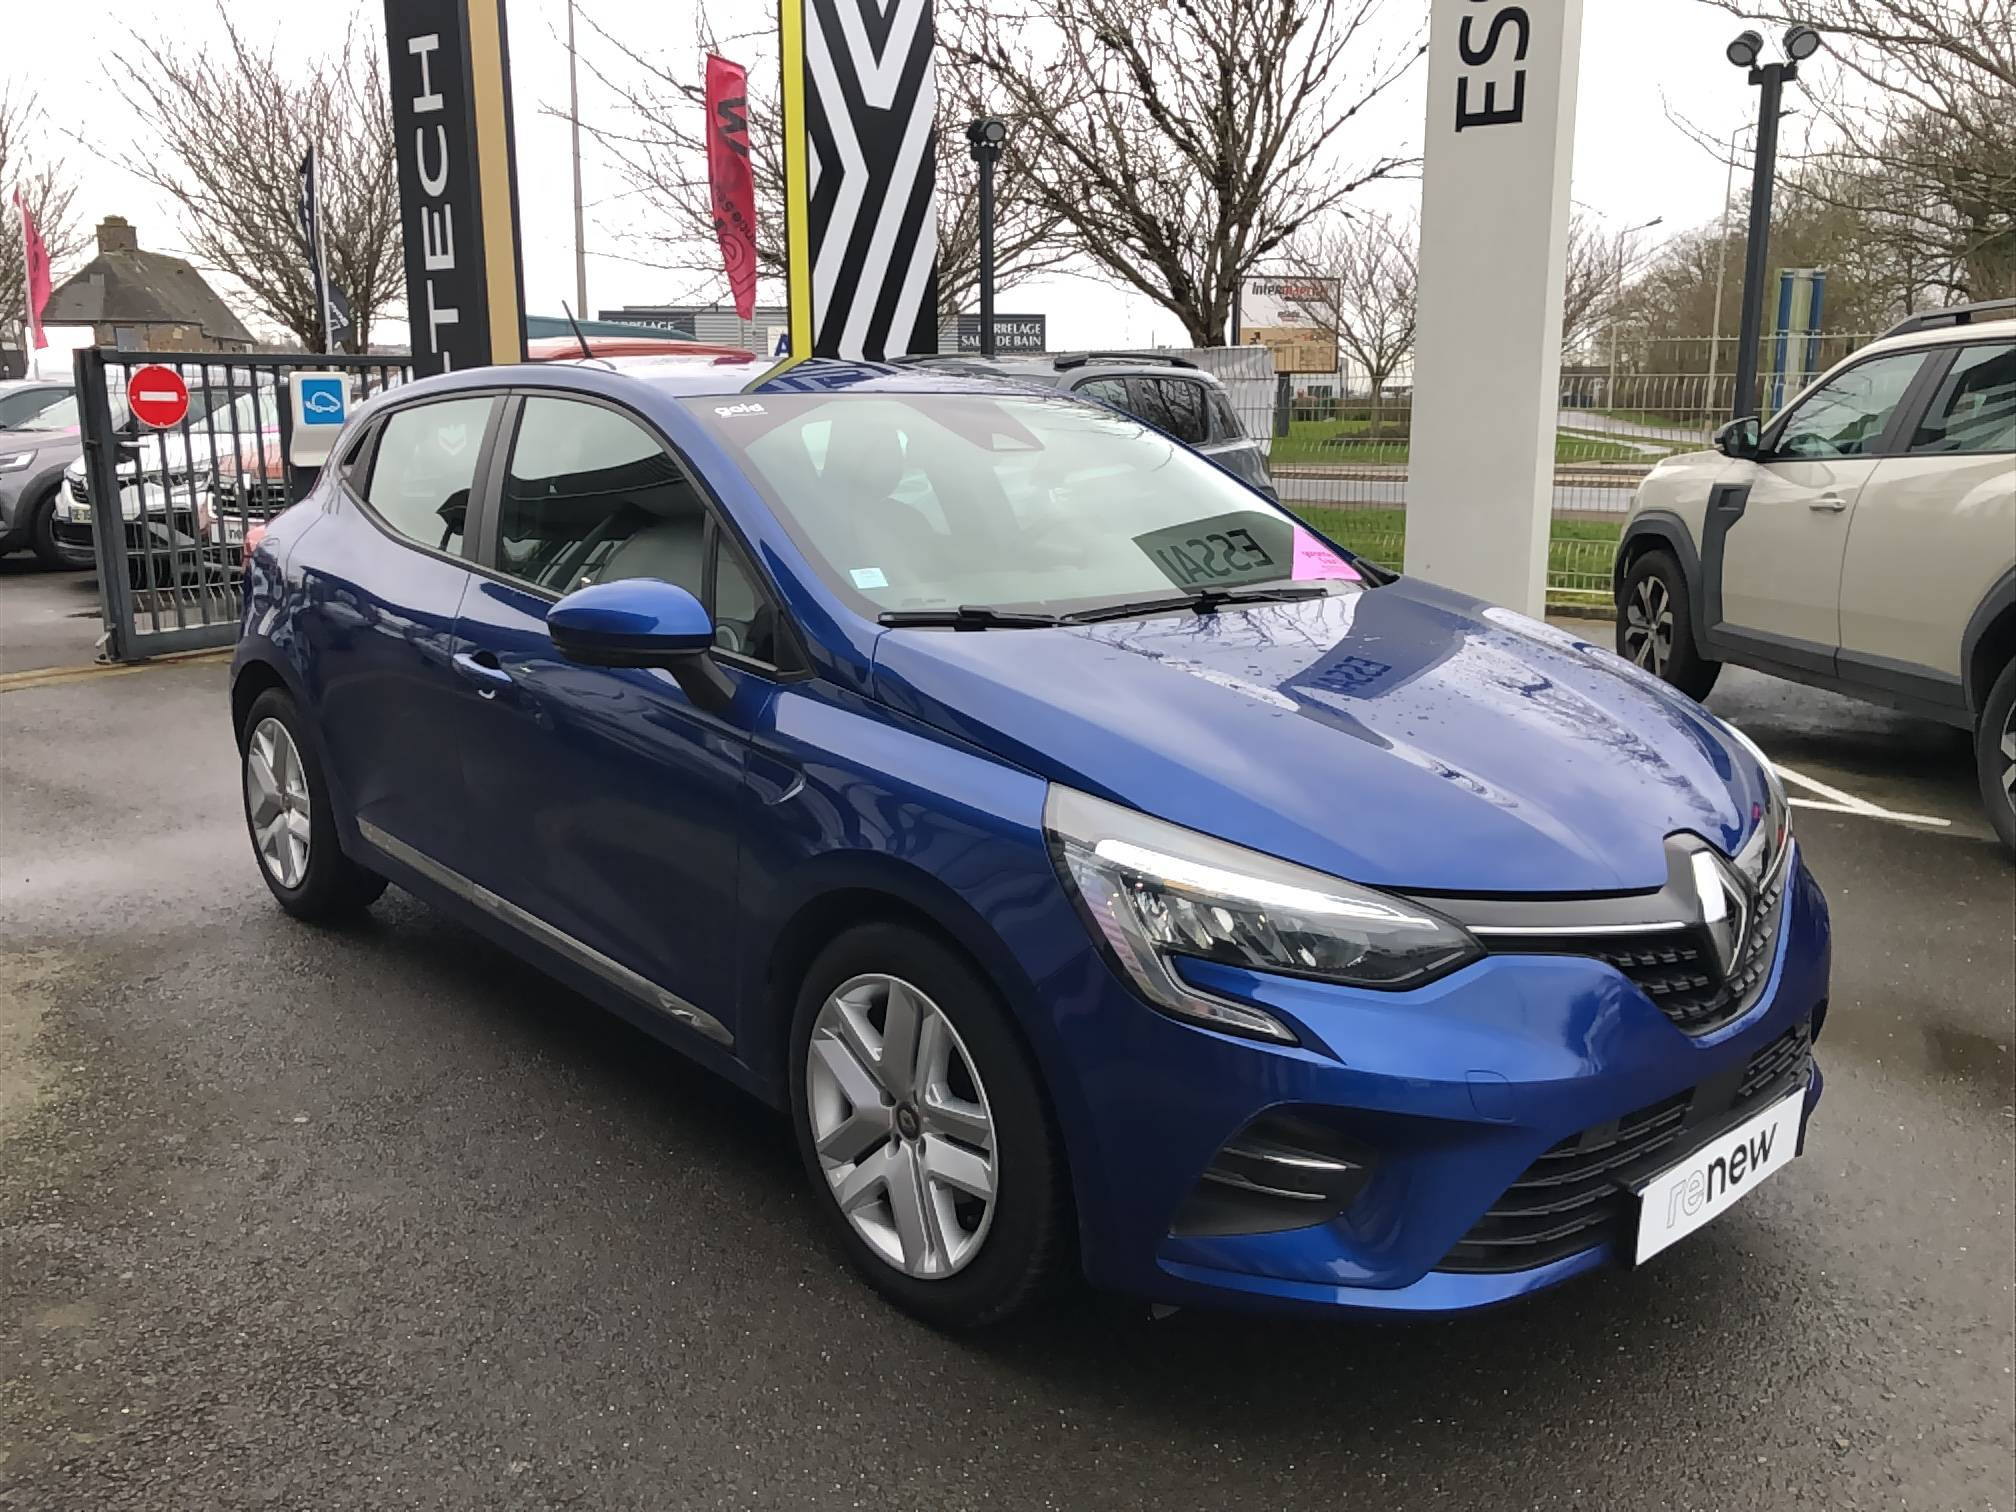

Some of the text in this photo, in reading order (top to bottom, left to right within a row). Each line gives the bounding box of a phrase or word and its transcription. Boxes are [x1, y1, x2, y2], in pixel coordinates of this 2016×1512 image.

[1455, 0, 1530, 133] ES
[996, 335, 1012, 347] DE
[1014, 335, 1042, 347] BAIN
[1666, 1127, 1778, 1229] renew
